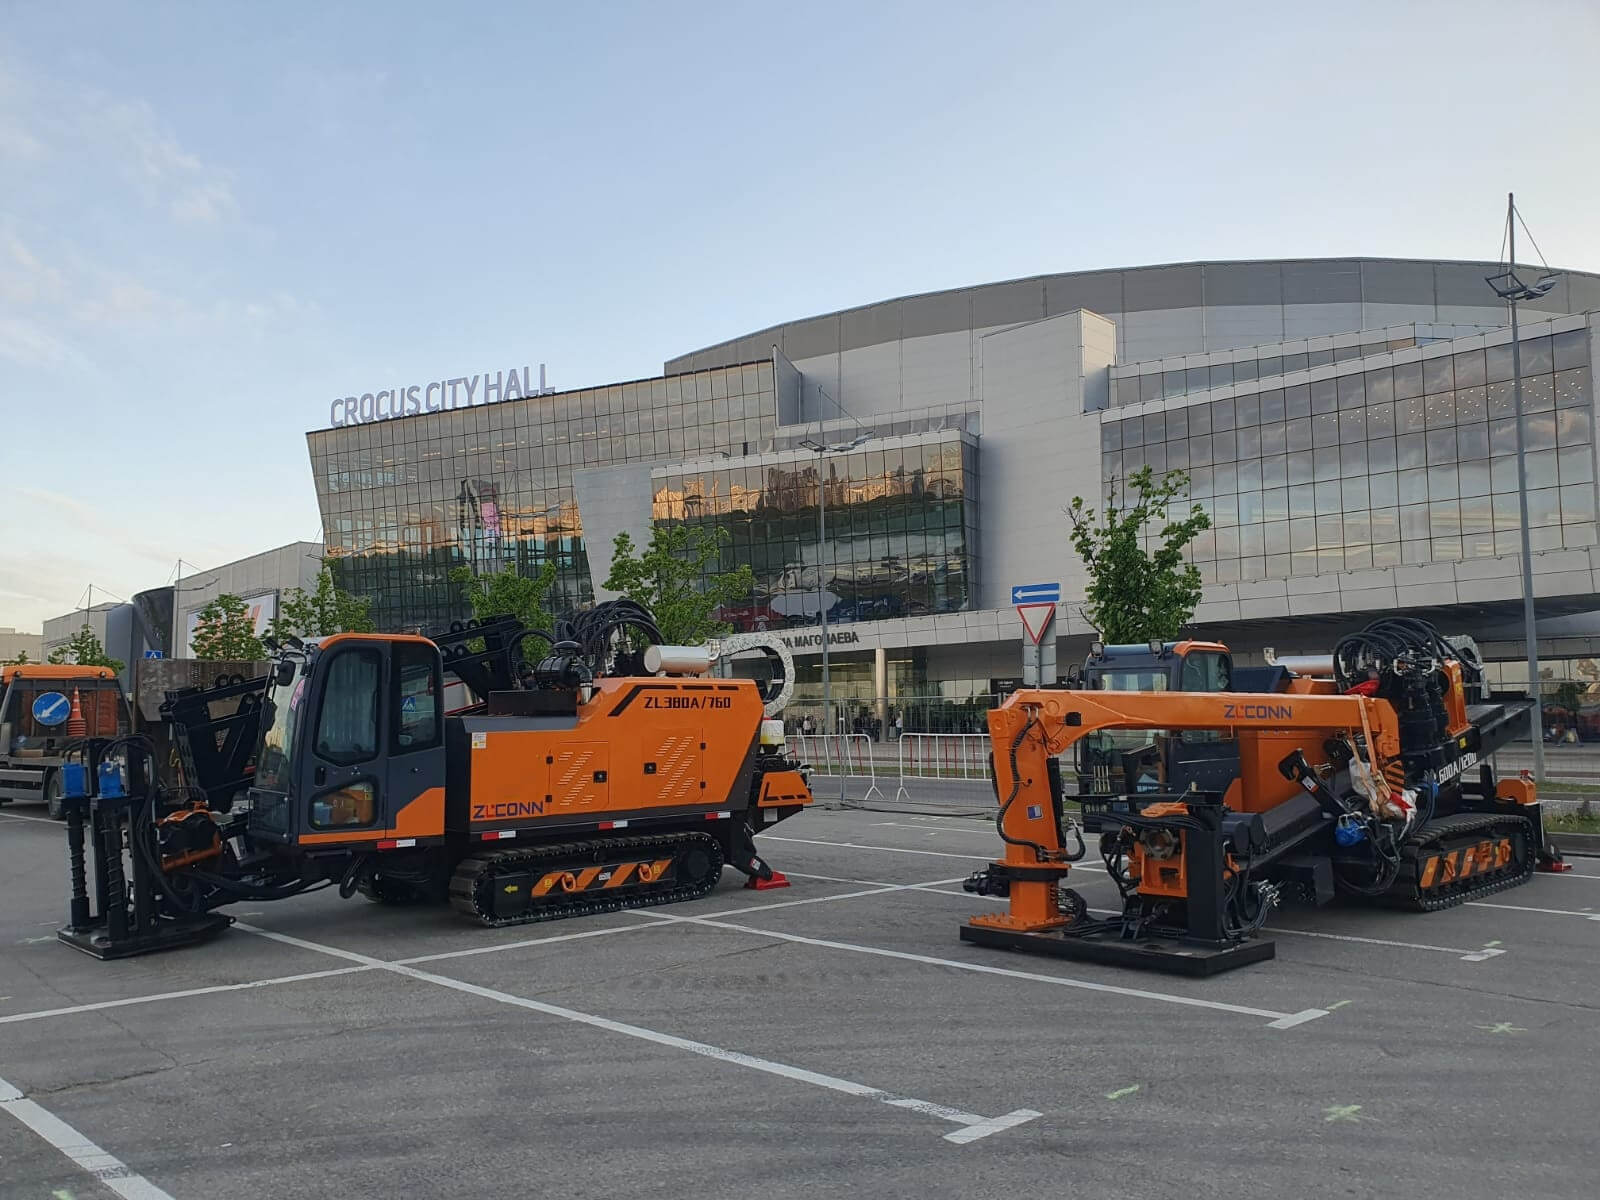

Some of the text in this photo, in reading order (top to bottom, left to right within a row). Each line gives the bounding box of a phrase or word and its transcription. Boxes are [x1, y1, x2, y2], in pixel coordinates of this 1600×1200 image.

[330, 363, 556, 428] CROCUS CITY HALL
[644, 696, 731, 709] ZL380A/760
